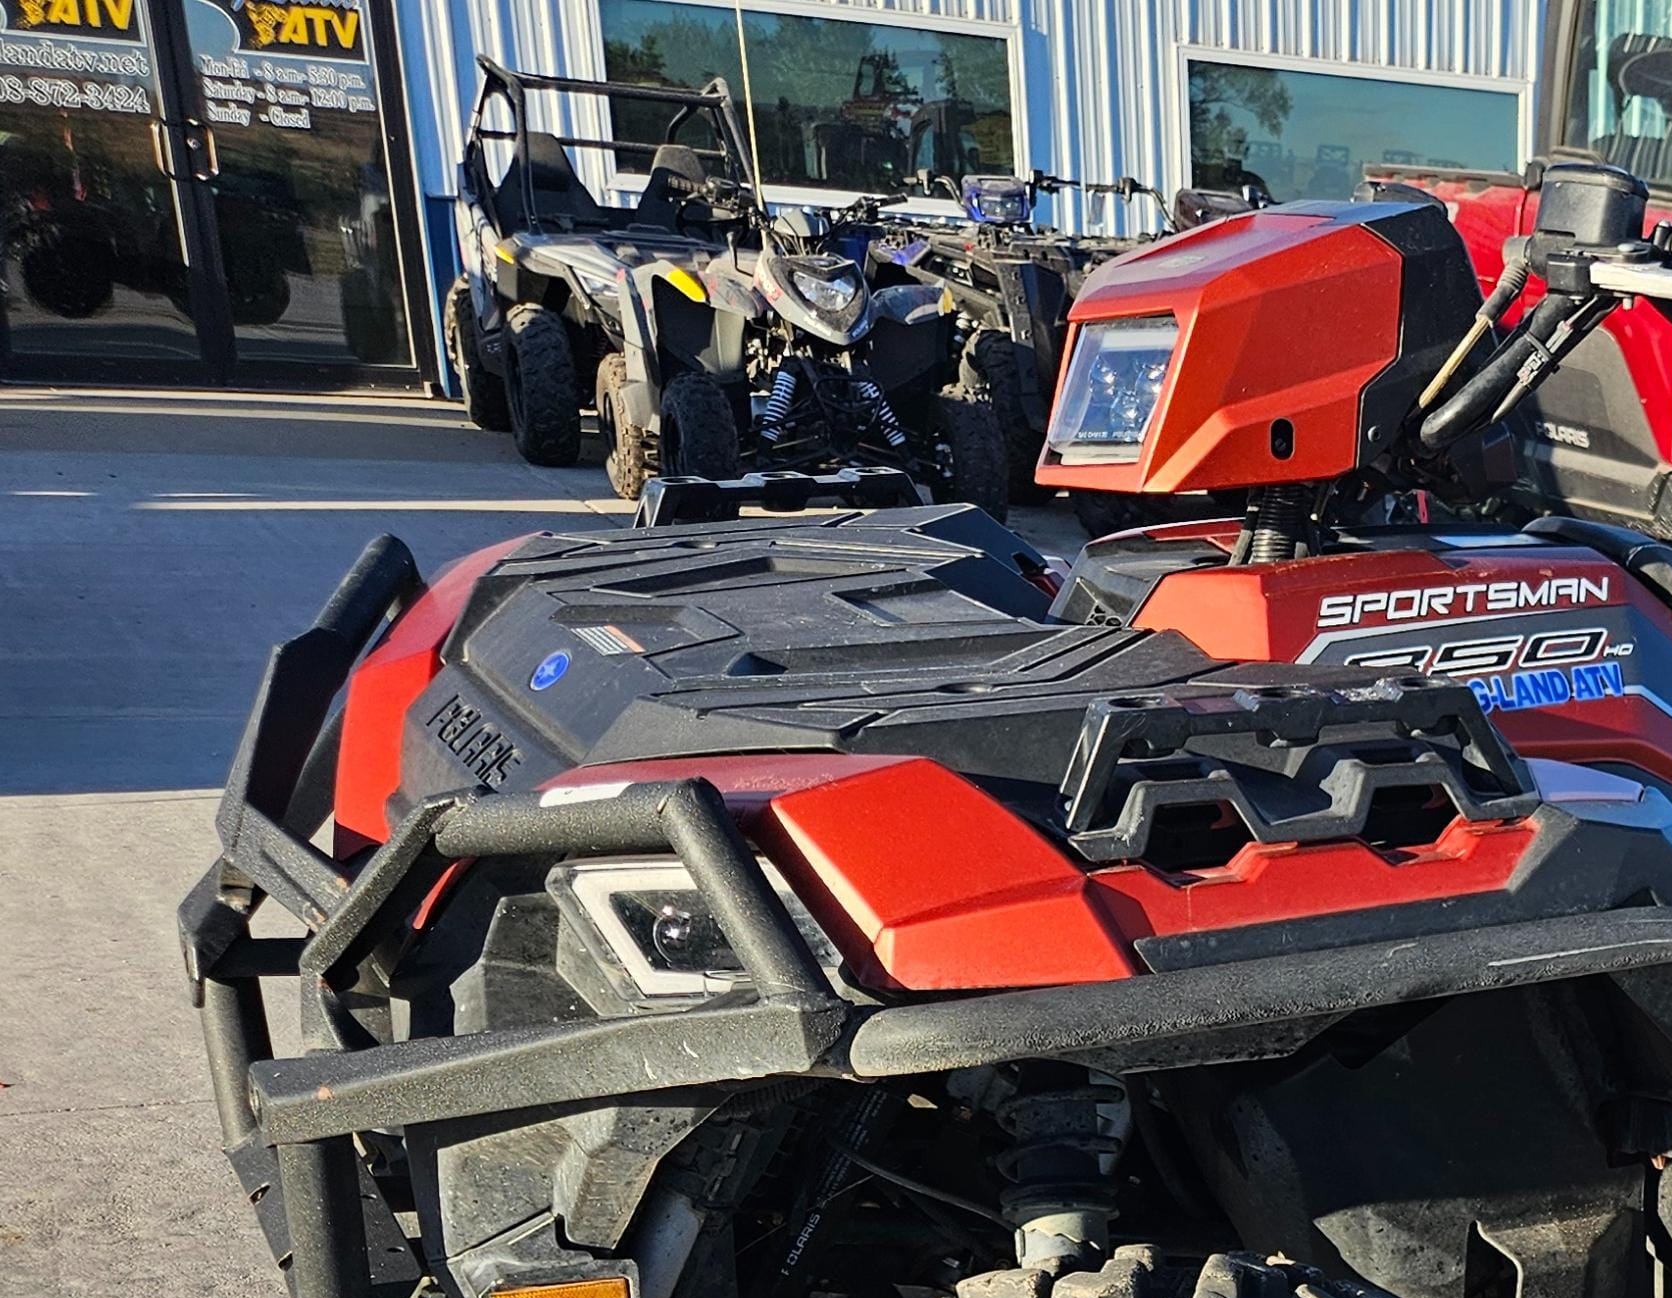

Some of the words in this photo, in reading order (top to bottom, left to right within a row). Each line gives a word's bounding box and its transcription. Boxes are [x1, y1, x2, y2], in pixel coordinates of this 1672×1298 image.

[279, 5, 358, 49] ATV
[202, 76, 257, 104] Saturday
[206, 100, 251, 127] Sunday
[268, 105, 311, 130] Closed
[1317, 576, 1609, 628] SPORTSMAN
[1571, 661, 1623, 700] ATV
[426, 692, 522, 794] POLARIS
